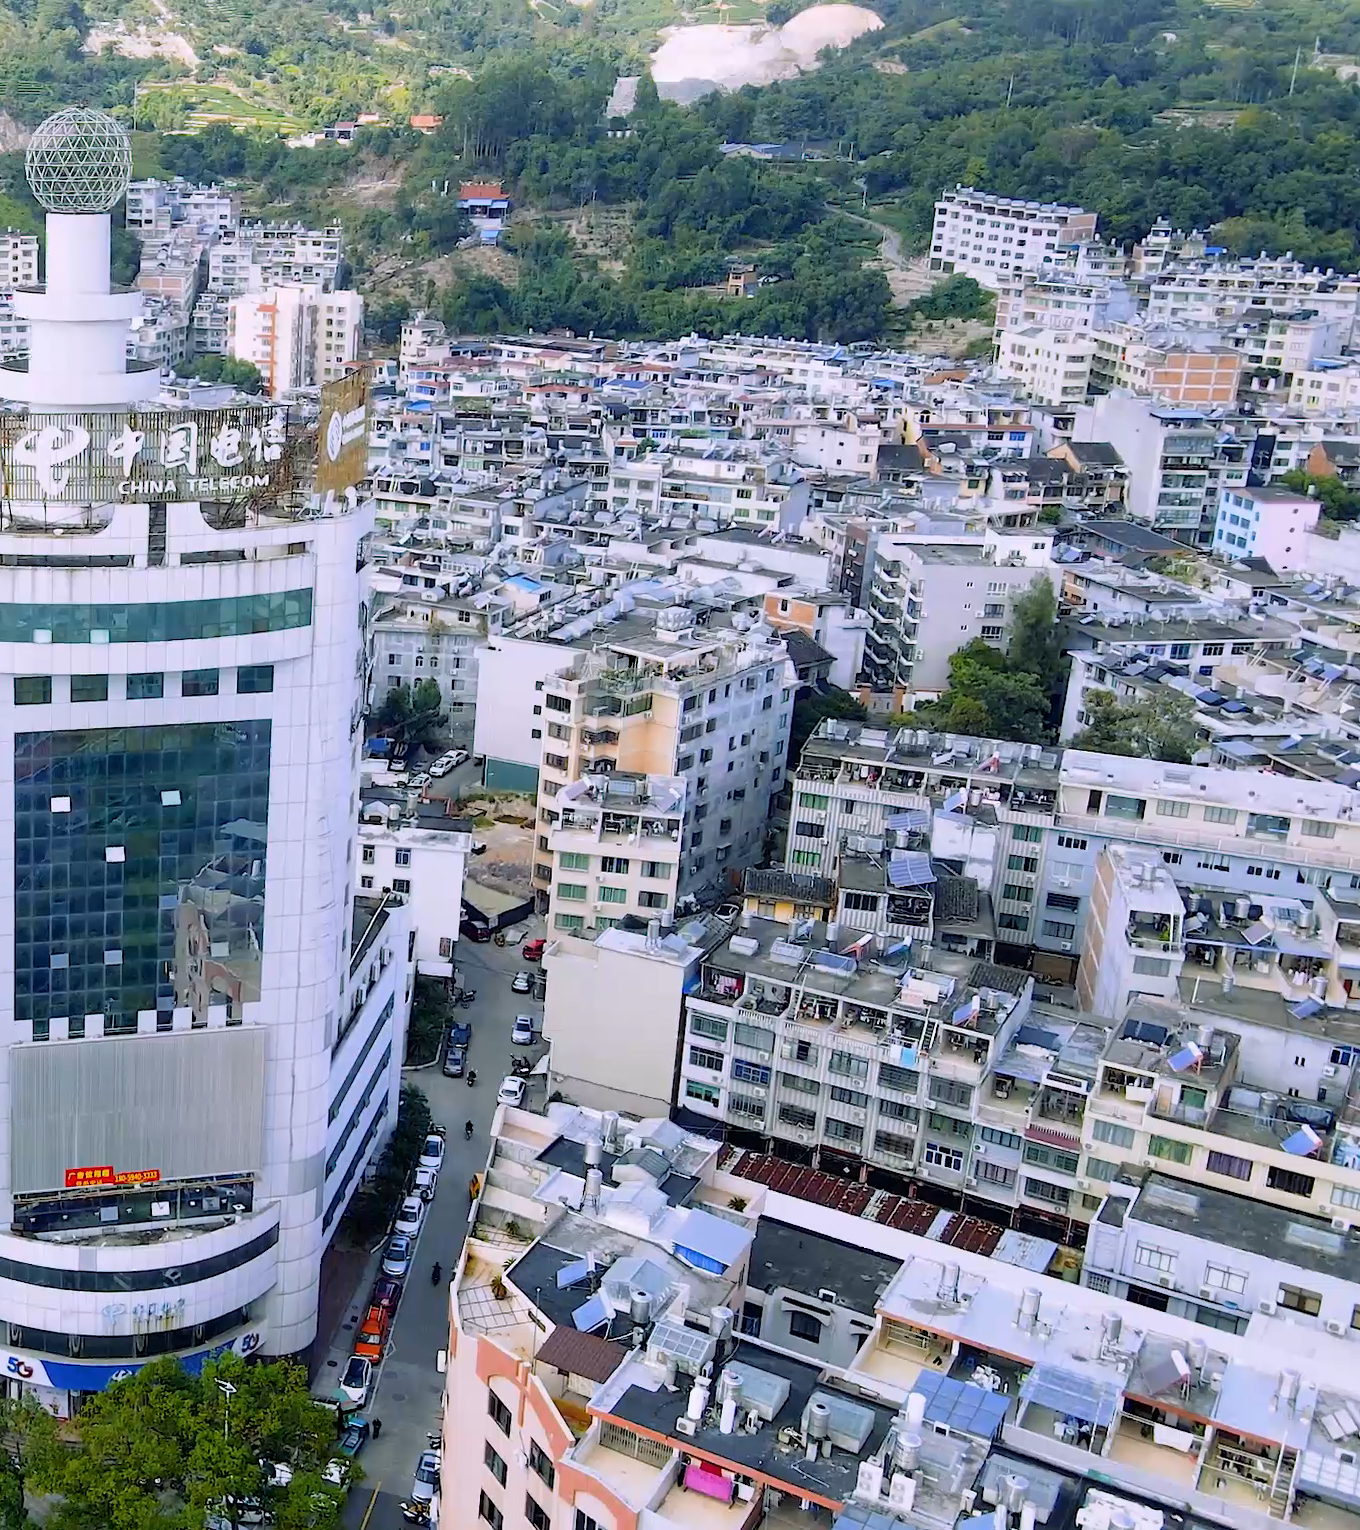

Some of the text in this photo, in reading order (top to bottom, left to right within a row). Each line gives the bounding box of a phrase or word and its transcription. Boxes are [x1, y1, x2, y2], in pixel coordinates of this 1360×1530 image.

[107, 418, 287, 477] 中国电信
[118, 475, 271, 495] CHINA TELECOM
[7, 1356, 34, 1379] 5G
